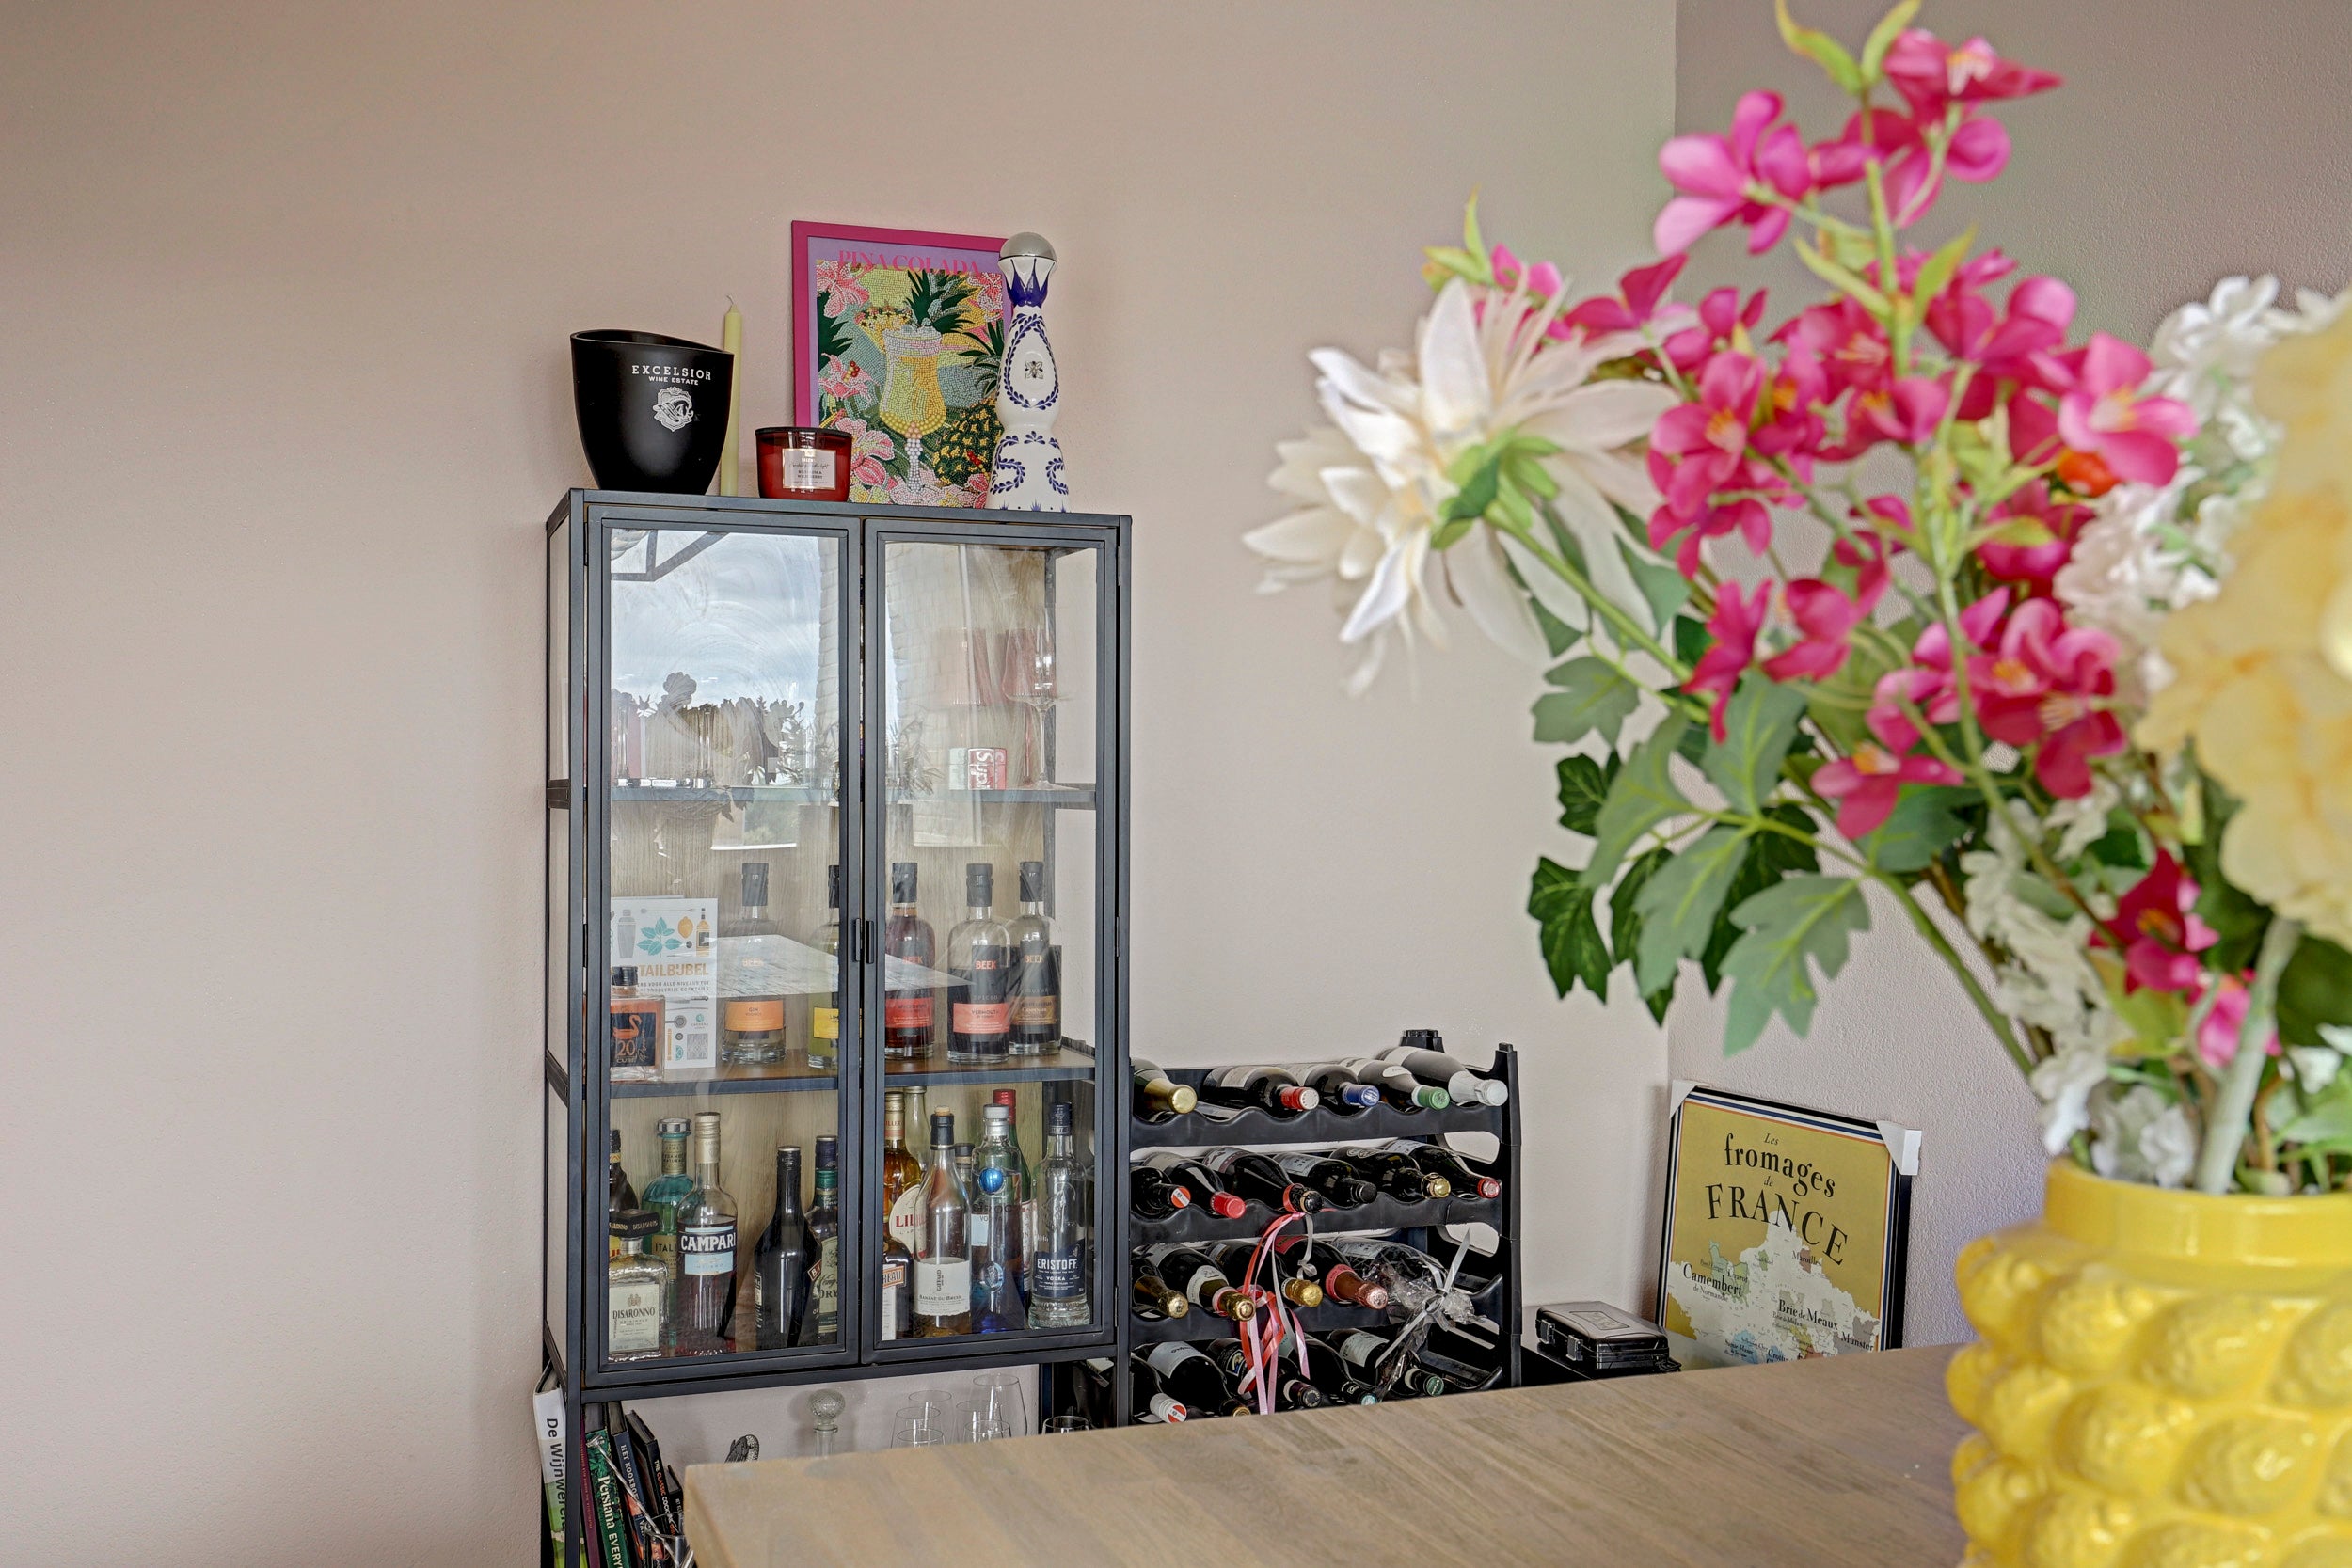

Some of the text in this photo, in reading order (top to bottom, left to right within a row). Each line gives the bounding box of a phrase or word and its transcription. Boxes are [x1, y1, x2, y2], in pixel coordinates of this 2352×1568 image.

[892, 254, 980, 277] COLADA
[631, 365, 711, 381] EXCELSIOR
[671, 377, 699, 386] ESTATE
[976, 960, 997, 970] BEEK
[617, 1040, 636, 1056] 20
[1764, 1133, 1779, 1146] Les
[1724, 1132, 1836, 1198] fromages
[1763, 1176, 1774, 1187] de
[1705, 1182, 1849, 1266] FRANCE
[681, 1232, 736, 1252] CAMPARI
[1037, 1258, 1078, 1270] ERISTOFF
[1683, 1263, 1742, 1298] Camembert
[612, 1307, 656, 1320] DISARONNO
[1779, 1299, 1798, 1316] Brie
[1807, 1307, 1838, 1330] Meaux
[1841, 1331, 1874, 1351] Munster
[547, 1418, 559, 1438] De
[621, 1444, 629, 1461] HET
[657, 1471, 666, 1497] CLASSIC
[598, 1475, 616, 1529] Persiana
